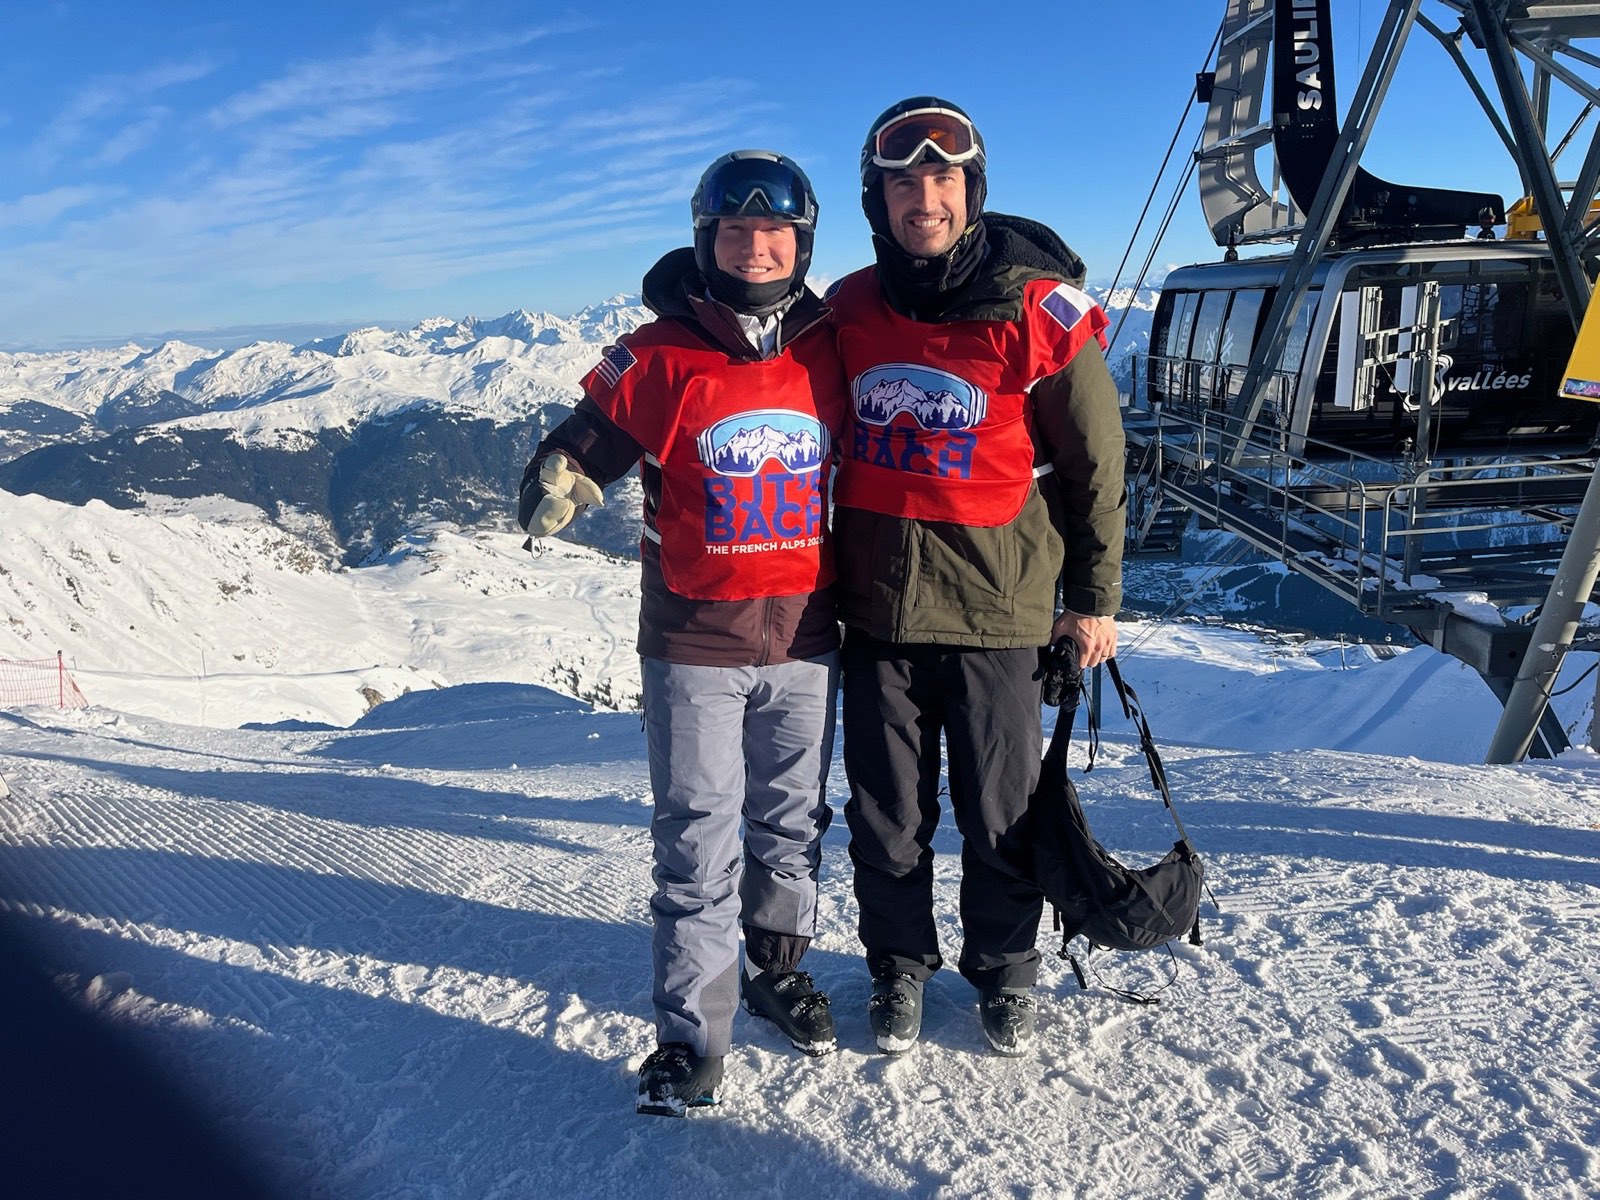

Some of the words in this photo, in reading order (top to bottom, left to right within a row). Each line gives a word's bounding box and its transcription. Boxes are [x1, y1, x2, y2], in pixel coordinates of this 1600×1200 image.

[1449, 370, 1532, 392] vallées
[705, 545, 729, 555] THE
[732, 542, 778, 554] FRENCH
[780, 537, 806, 550] ALPS
